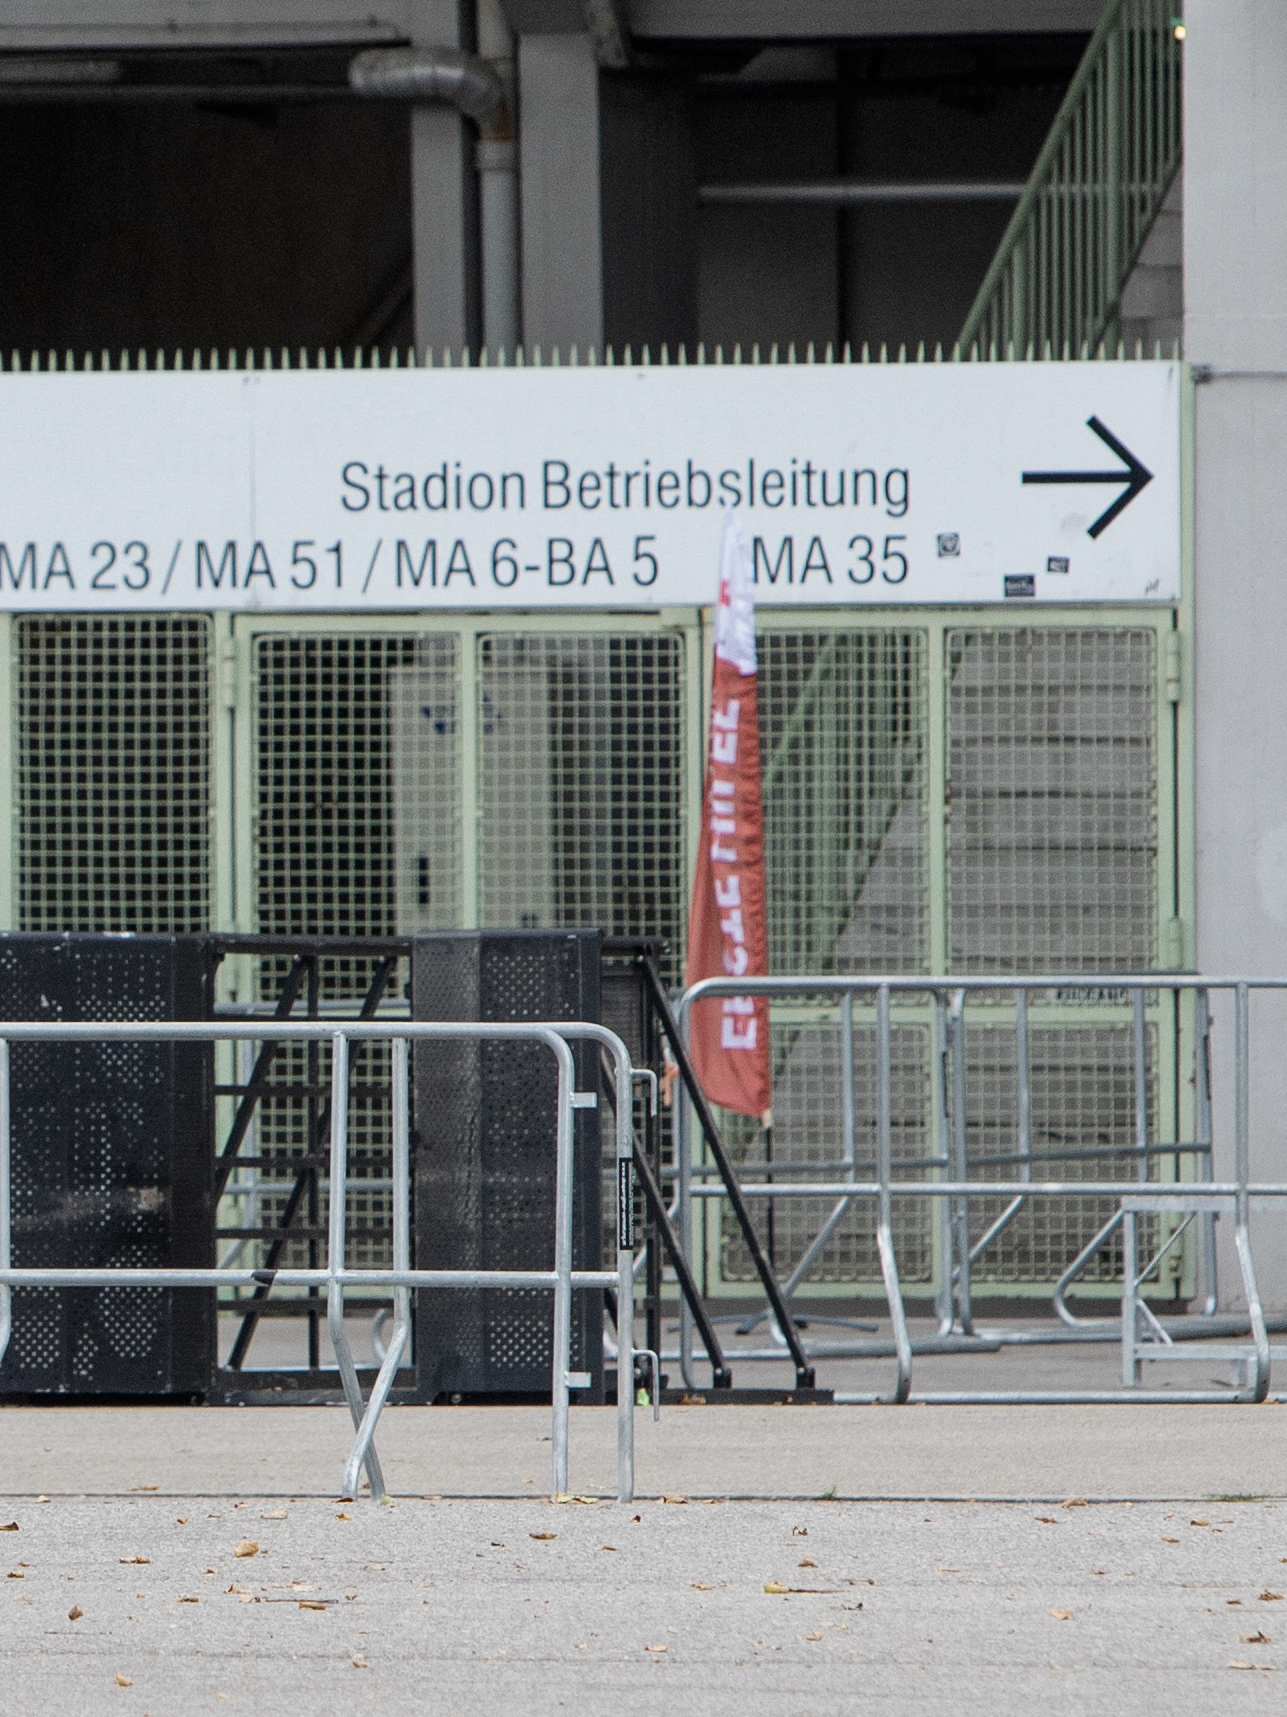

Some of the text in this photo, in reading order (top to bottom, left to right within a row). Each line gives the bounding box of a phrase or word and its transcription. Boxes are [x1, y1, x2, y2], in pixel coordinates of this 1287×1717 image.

[341, 459, 909, 518] Stadion Betriebsleitung
[90, 542, 150, 591] 23
[196, 541, 276, 589] MA
[291, 540, 342, 590] 51
[396, 540, 476, 588] MA
[491, 538, 615, 588] 6-BA
[633, 536, 659, 587] 5
[752, 536, 833, 584] MA
[847, 536, 909, 585] 35
